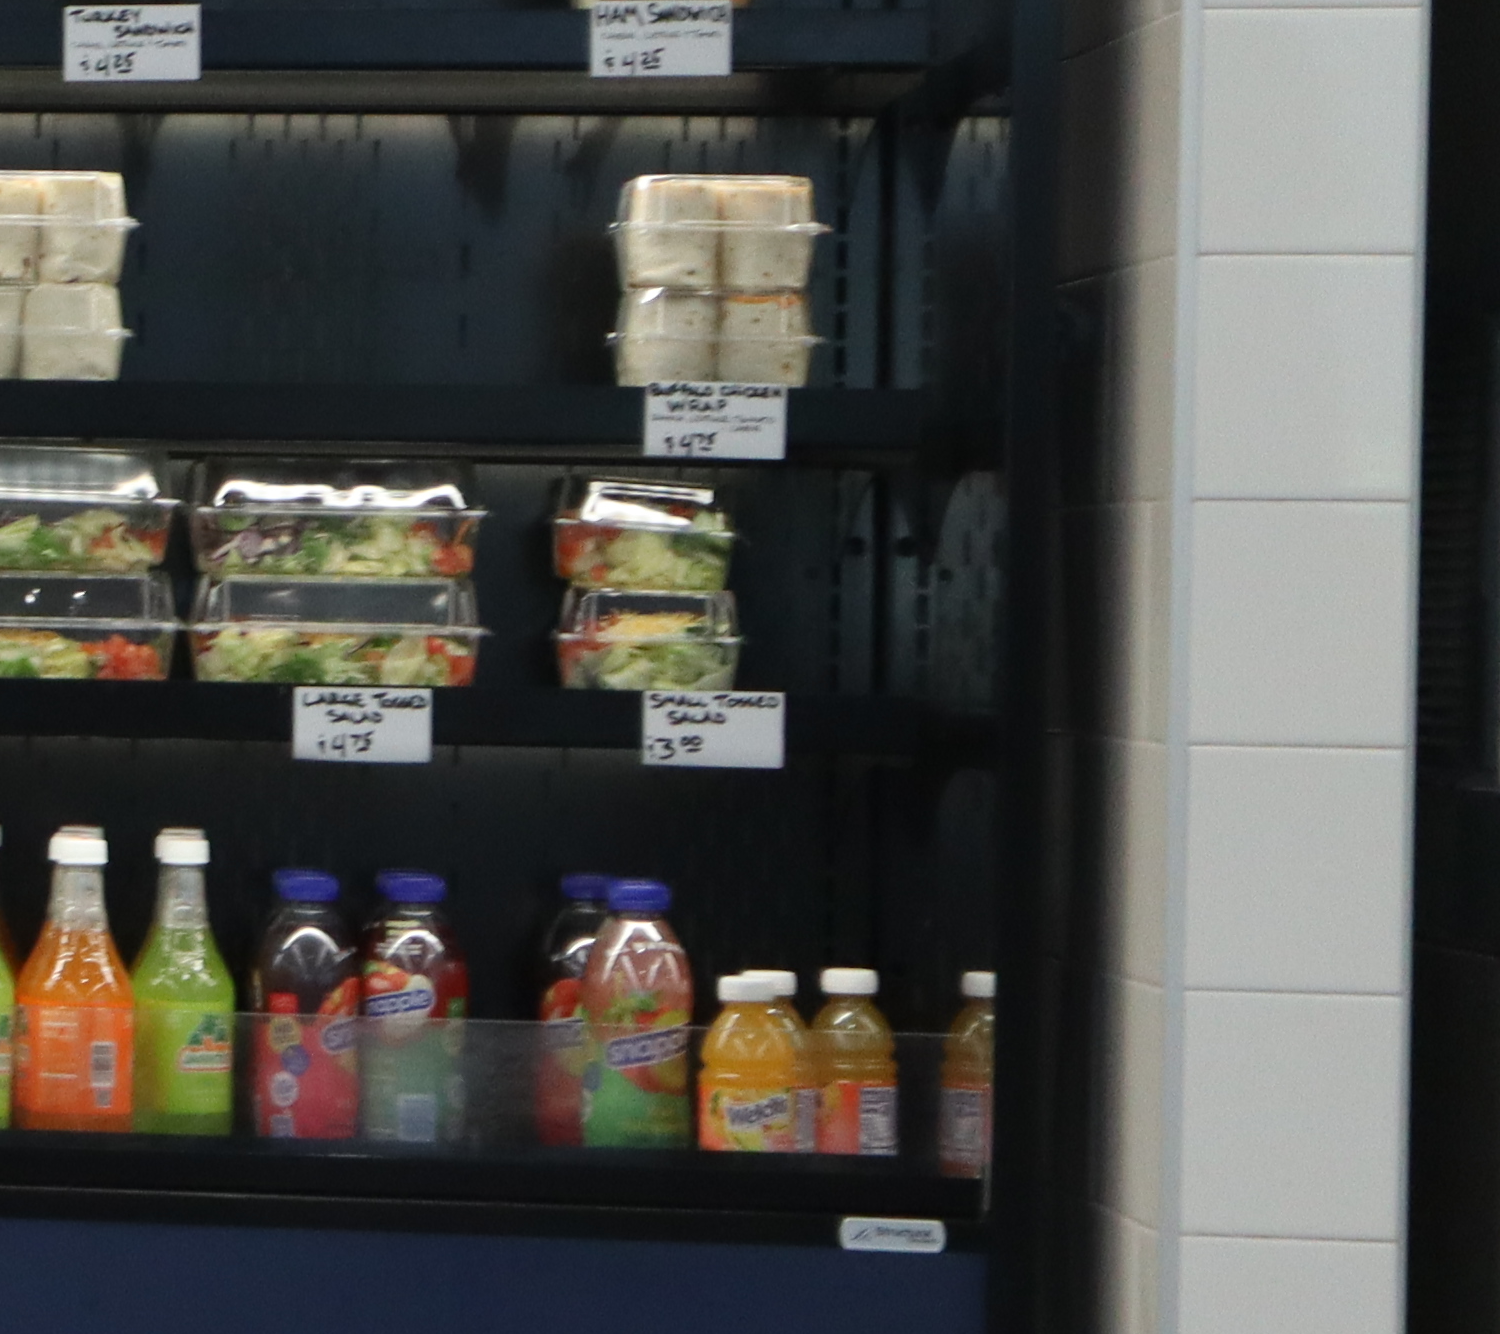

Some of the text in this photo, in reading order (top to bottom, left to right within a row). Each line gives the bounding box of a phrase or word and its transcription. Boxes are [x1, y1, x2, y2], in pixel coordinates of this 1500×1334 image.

[666, 398, 728, 413] WRAP
[650, 692, 709, 709] SMALL
[325, 708, 384, 725] SALAD
[666, 710, 727, 726] SALAD
